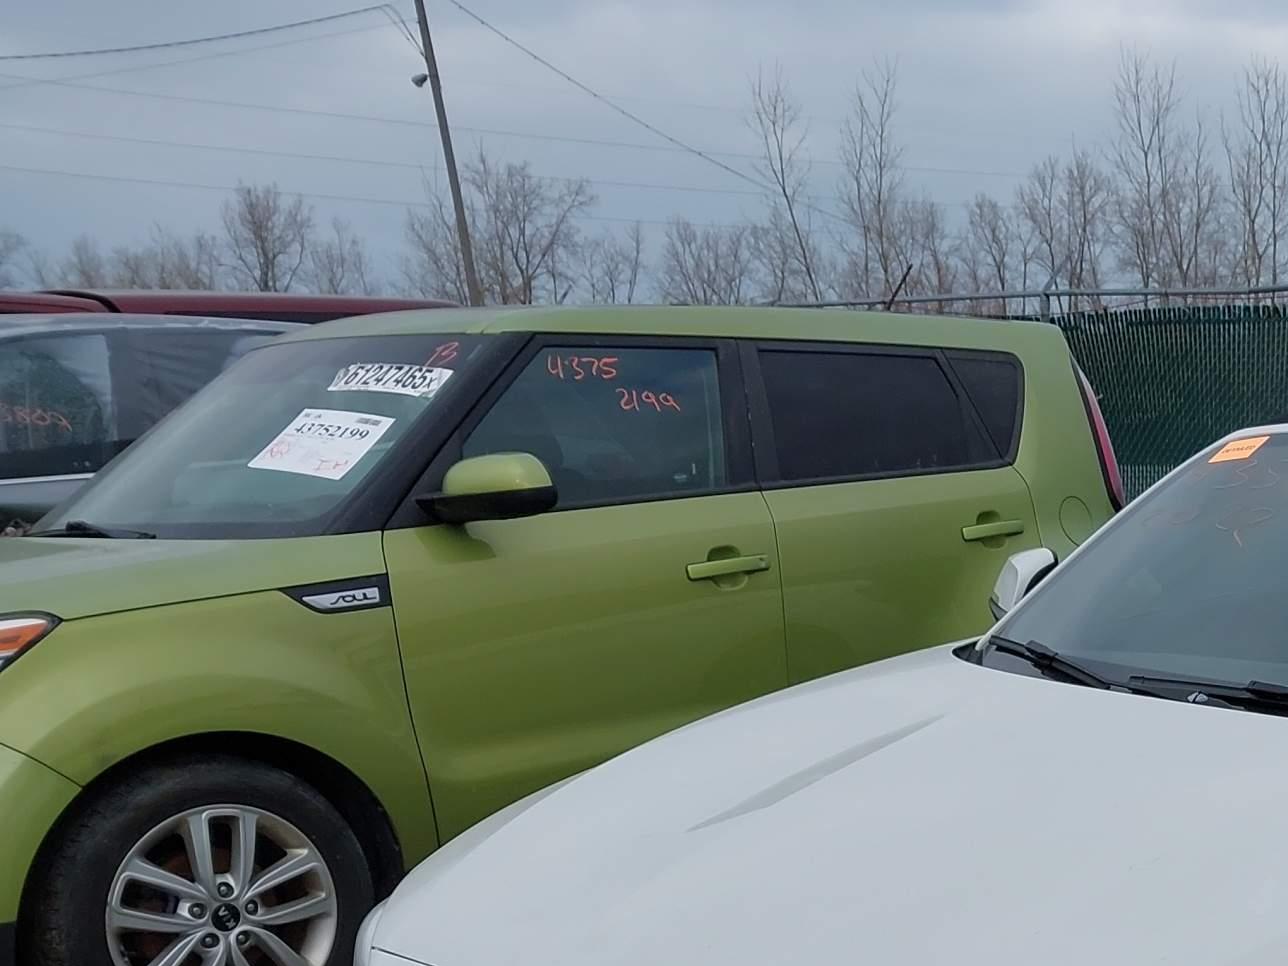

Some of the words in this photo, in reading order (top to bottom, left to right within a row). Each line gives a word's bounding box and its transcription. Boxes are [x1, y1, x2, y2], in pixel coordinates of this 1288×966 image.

[547, 354, 618, 380] 4375
[615, 387, 681, 411] 2199
[294, 422, 370, 440] 43752199
